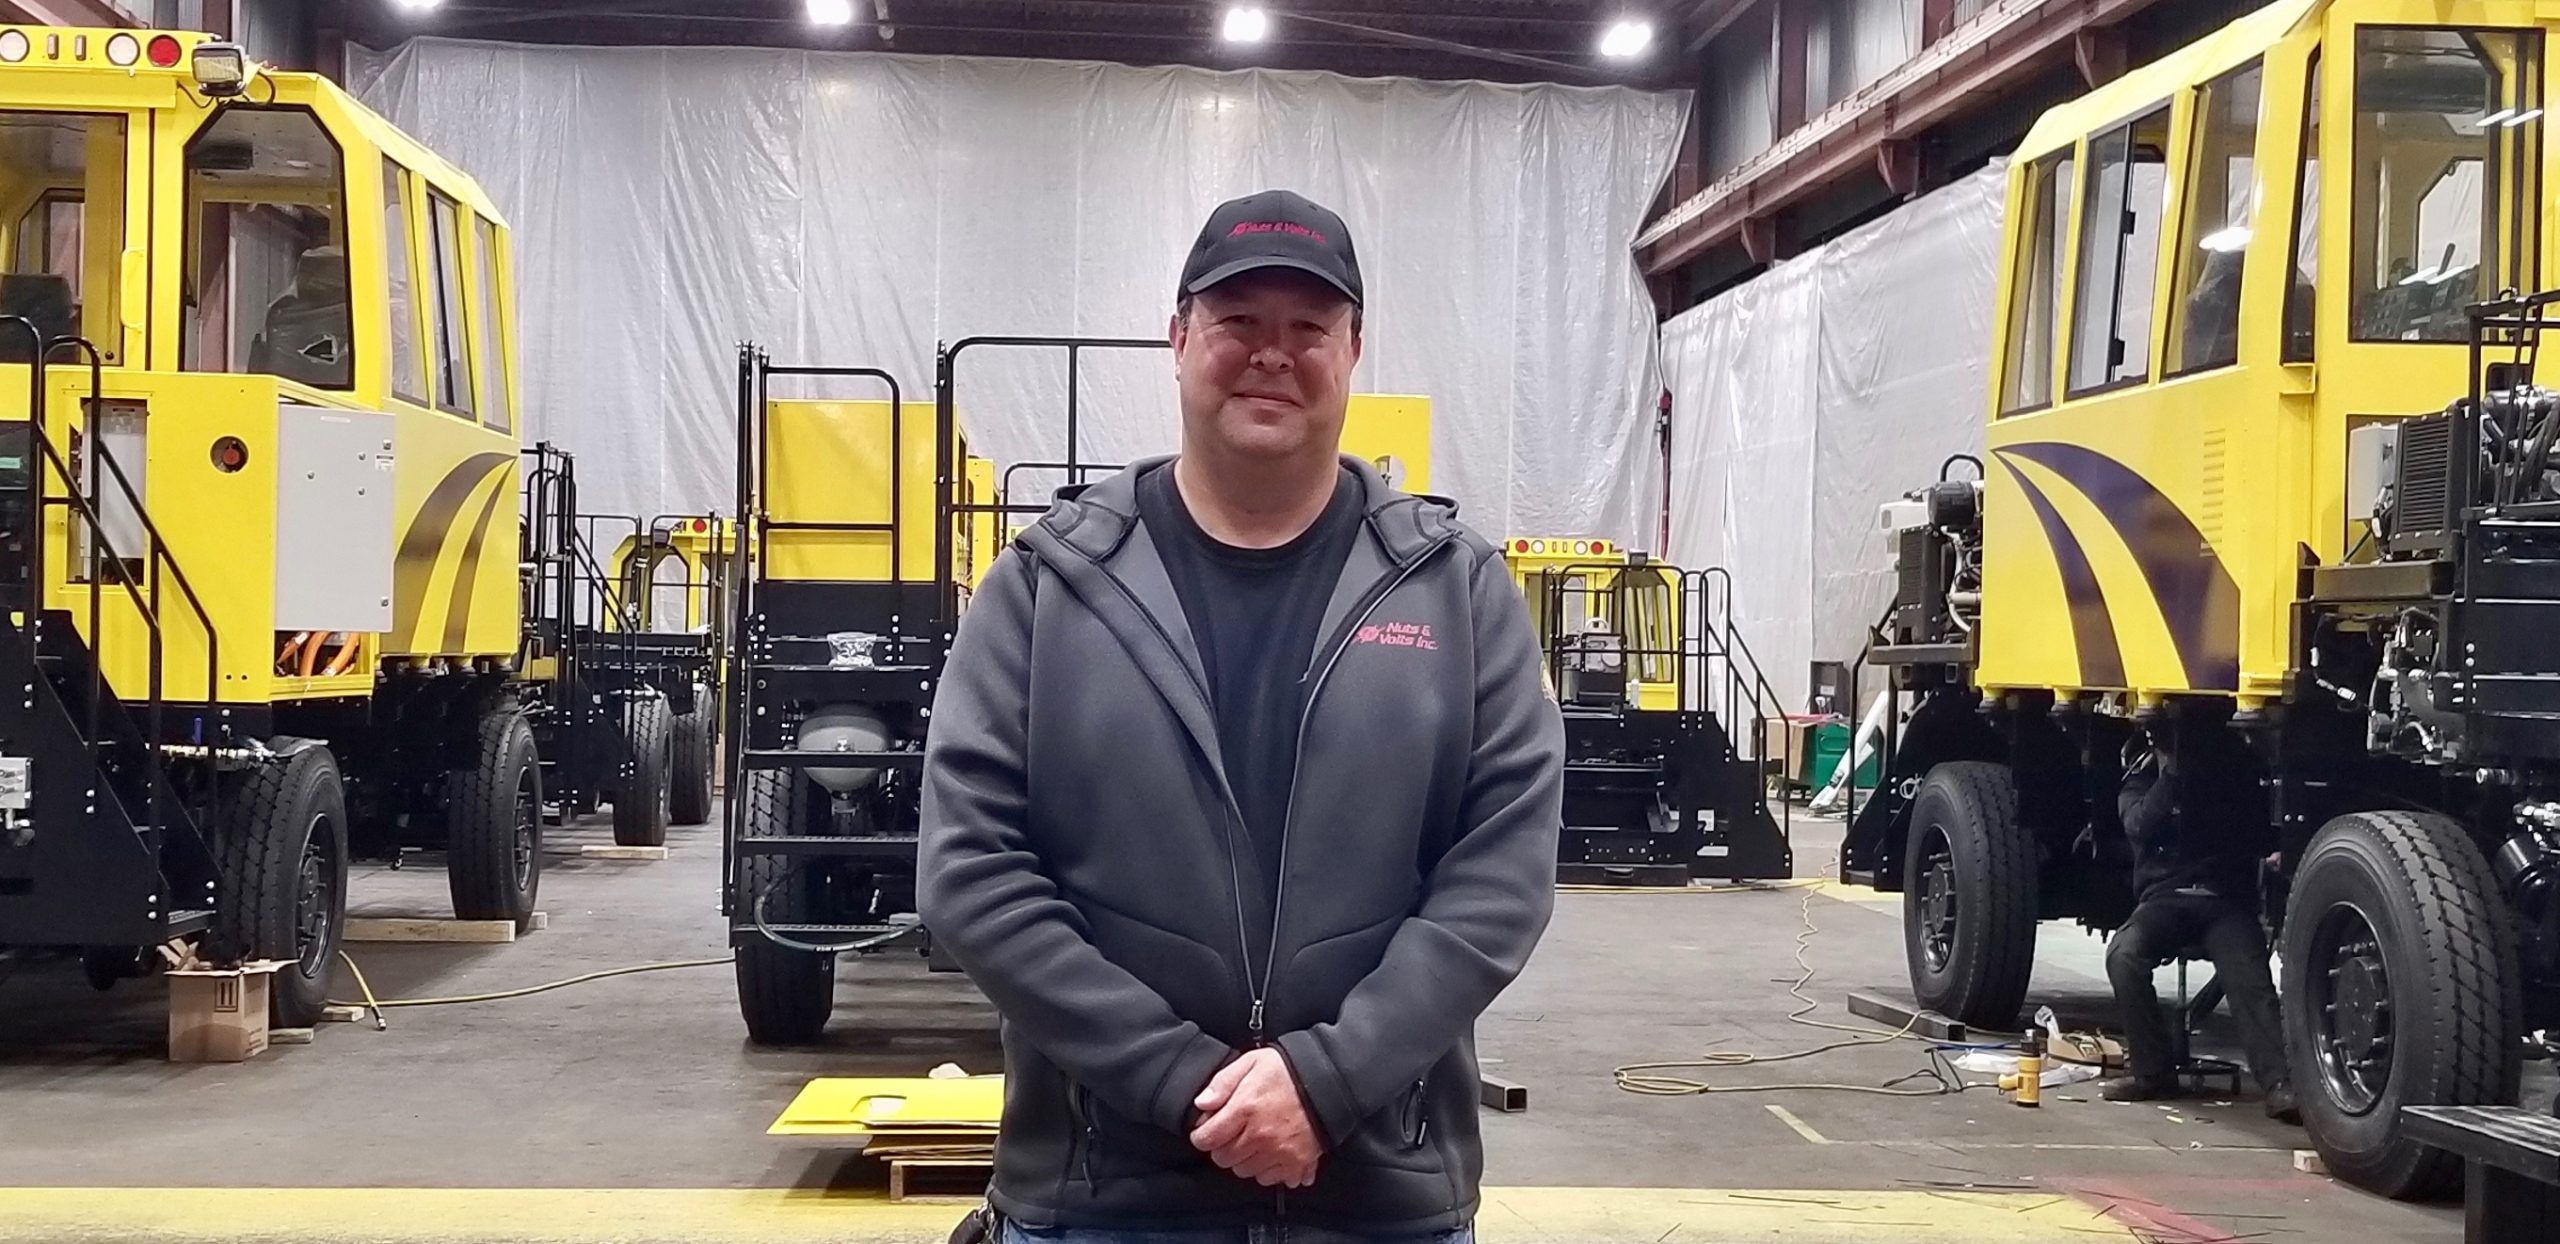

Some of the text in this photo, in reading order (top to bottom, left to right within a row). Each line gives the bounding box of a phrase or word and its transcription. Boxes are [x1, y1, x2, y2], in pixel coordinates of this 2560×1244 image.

[1386, 622, 1432, 637] Nuts &
[1380, 633, 1415, 646] Volts
